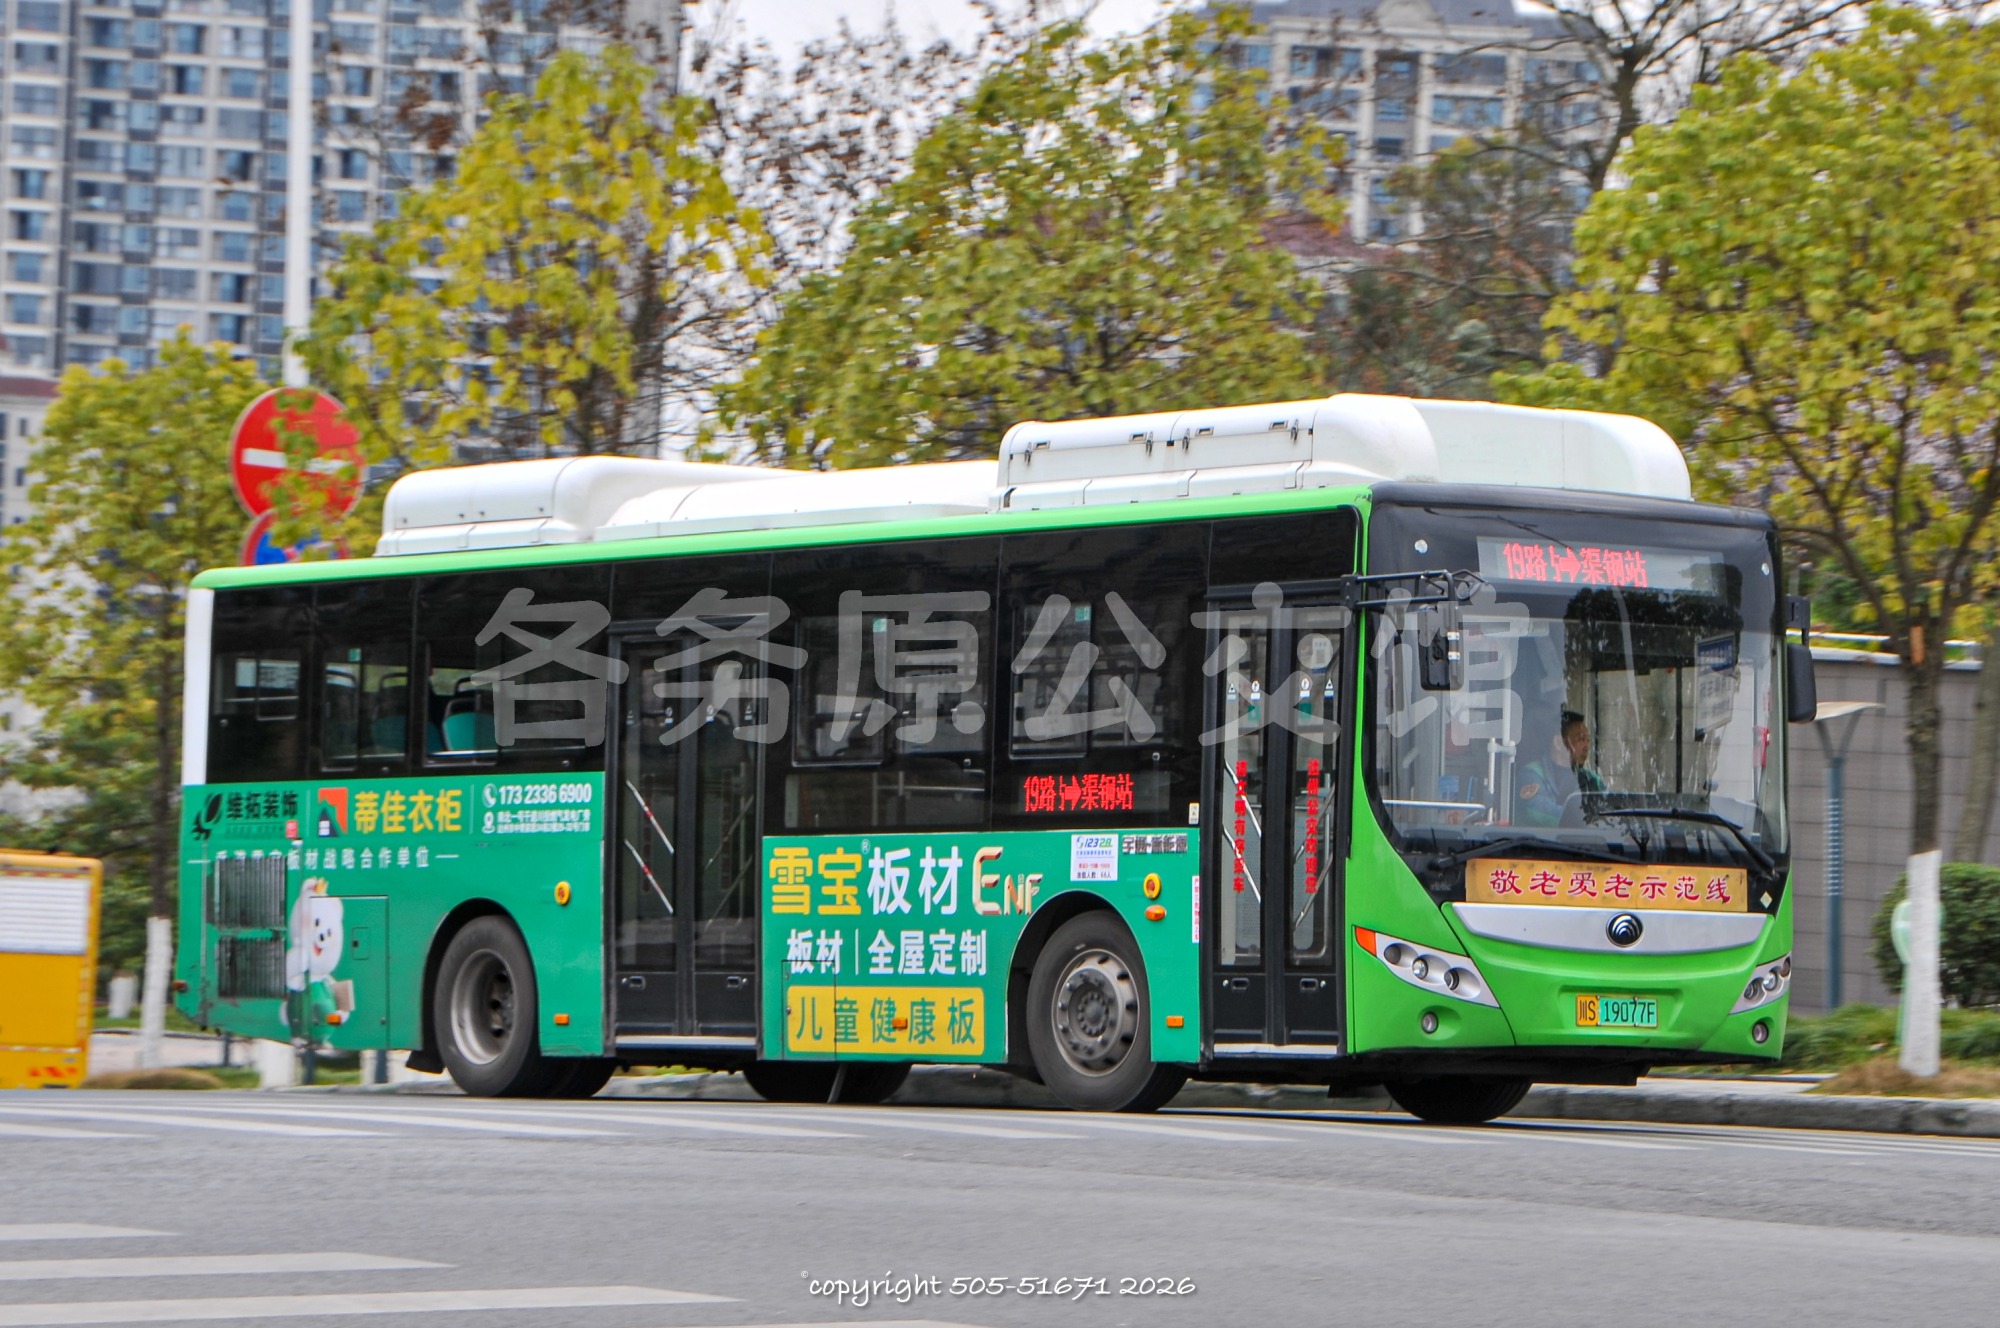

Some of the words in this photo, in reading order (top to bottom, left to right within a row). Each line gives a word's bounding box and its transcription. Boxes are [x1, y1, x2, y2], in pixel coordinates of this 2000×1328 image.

[354, 789, 463, 834] 蒂佳衣柜
[499, 785, 522, 804] 173
[524, 784, 557, 804] 2336
[559, 783, 592, 803] 6900
[1024, 775, 1057, 812] 19路
[1084, 837, 1112, 849] 12328
[1489, 868, 1732, 905] 敬老爱老示范线
[786, 928, 843, 974] 板材
[868, 928, 987, 976] 全屋定制
[796, 996, 977, 1045] 儿童健康板
